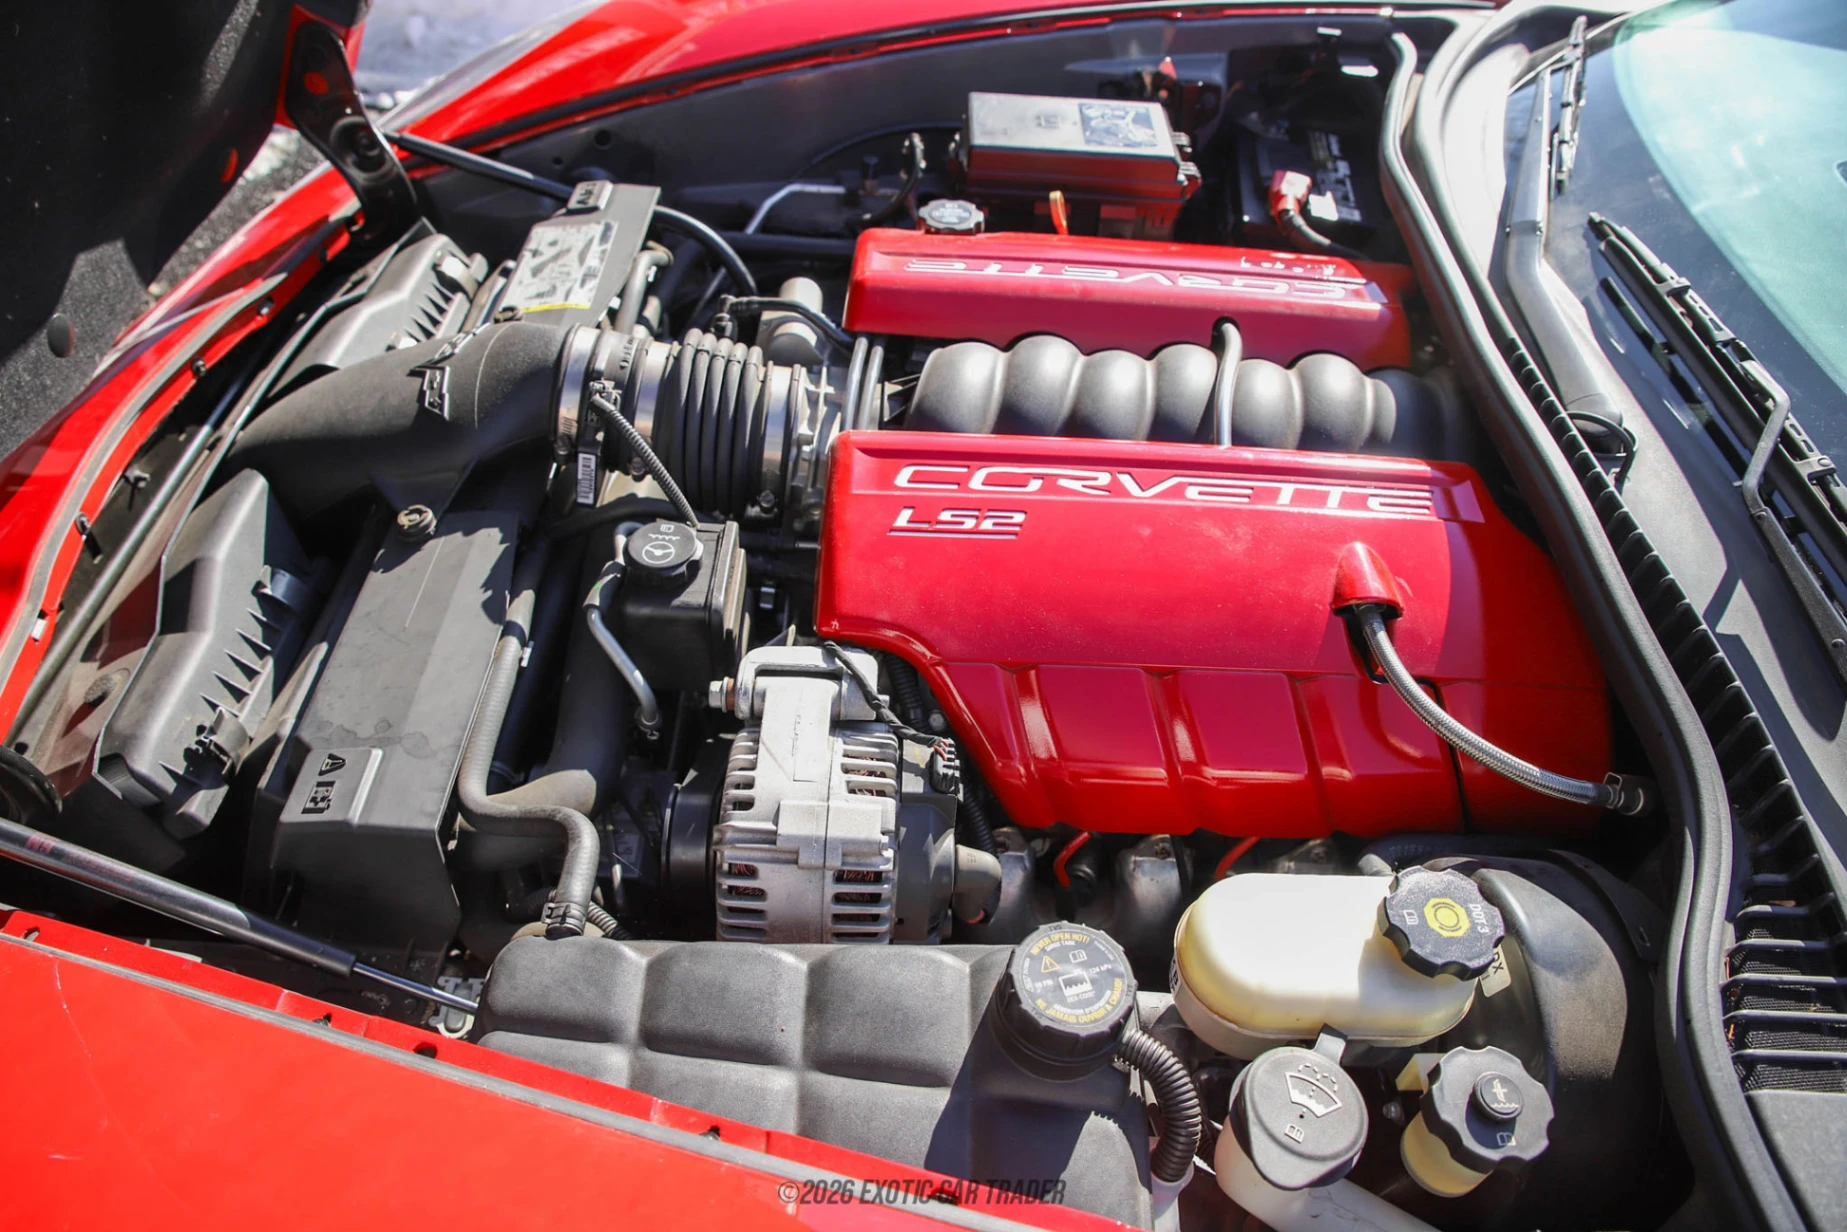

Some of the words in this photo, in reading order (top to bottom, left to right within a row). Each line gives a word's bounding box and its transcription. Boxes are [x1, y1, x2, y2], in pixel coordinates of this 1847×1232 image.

[903, 257, 1347, 300] CORVETTE
[893, 464, 1434, 514] CORVETTE
[892, 506, 1027, 532] LS2
[1469, 903, 1488, 926] DOT
[1477, 925, 1489, 933] 3
[1030, 937, 1051, 955] NEVER
[1051, 932, 1070, 942] OPEN
[1070, 932, 1090, 944] HOT!
[1035, 998, 1048, 1010] NE
[1045, 1006, 1077, 1023] JAMAIS
[1078, 1007, 1107, 1023] OUVRIR
[1108, 977, 1123, 1006] CHAUD!
